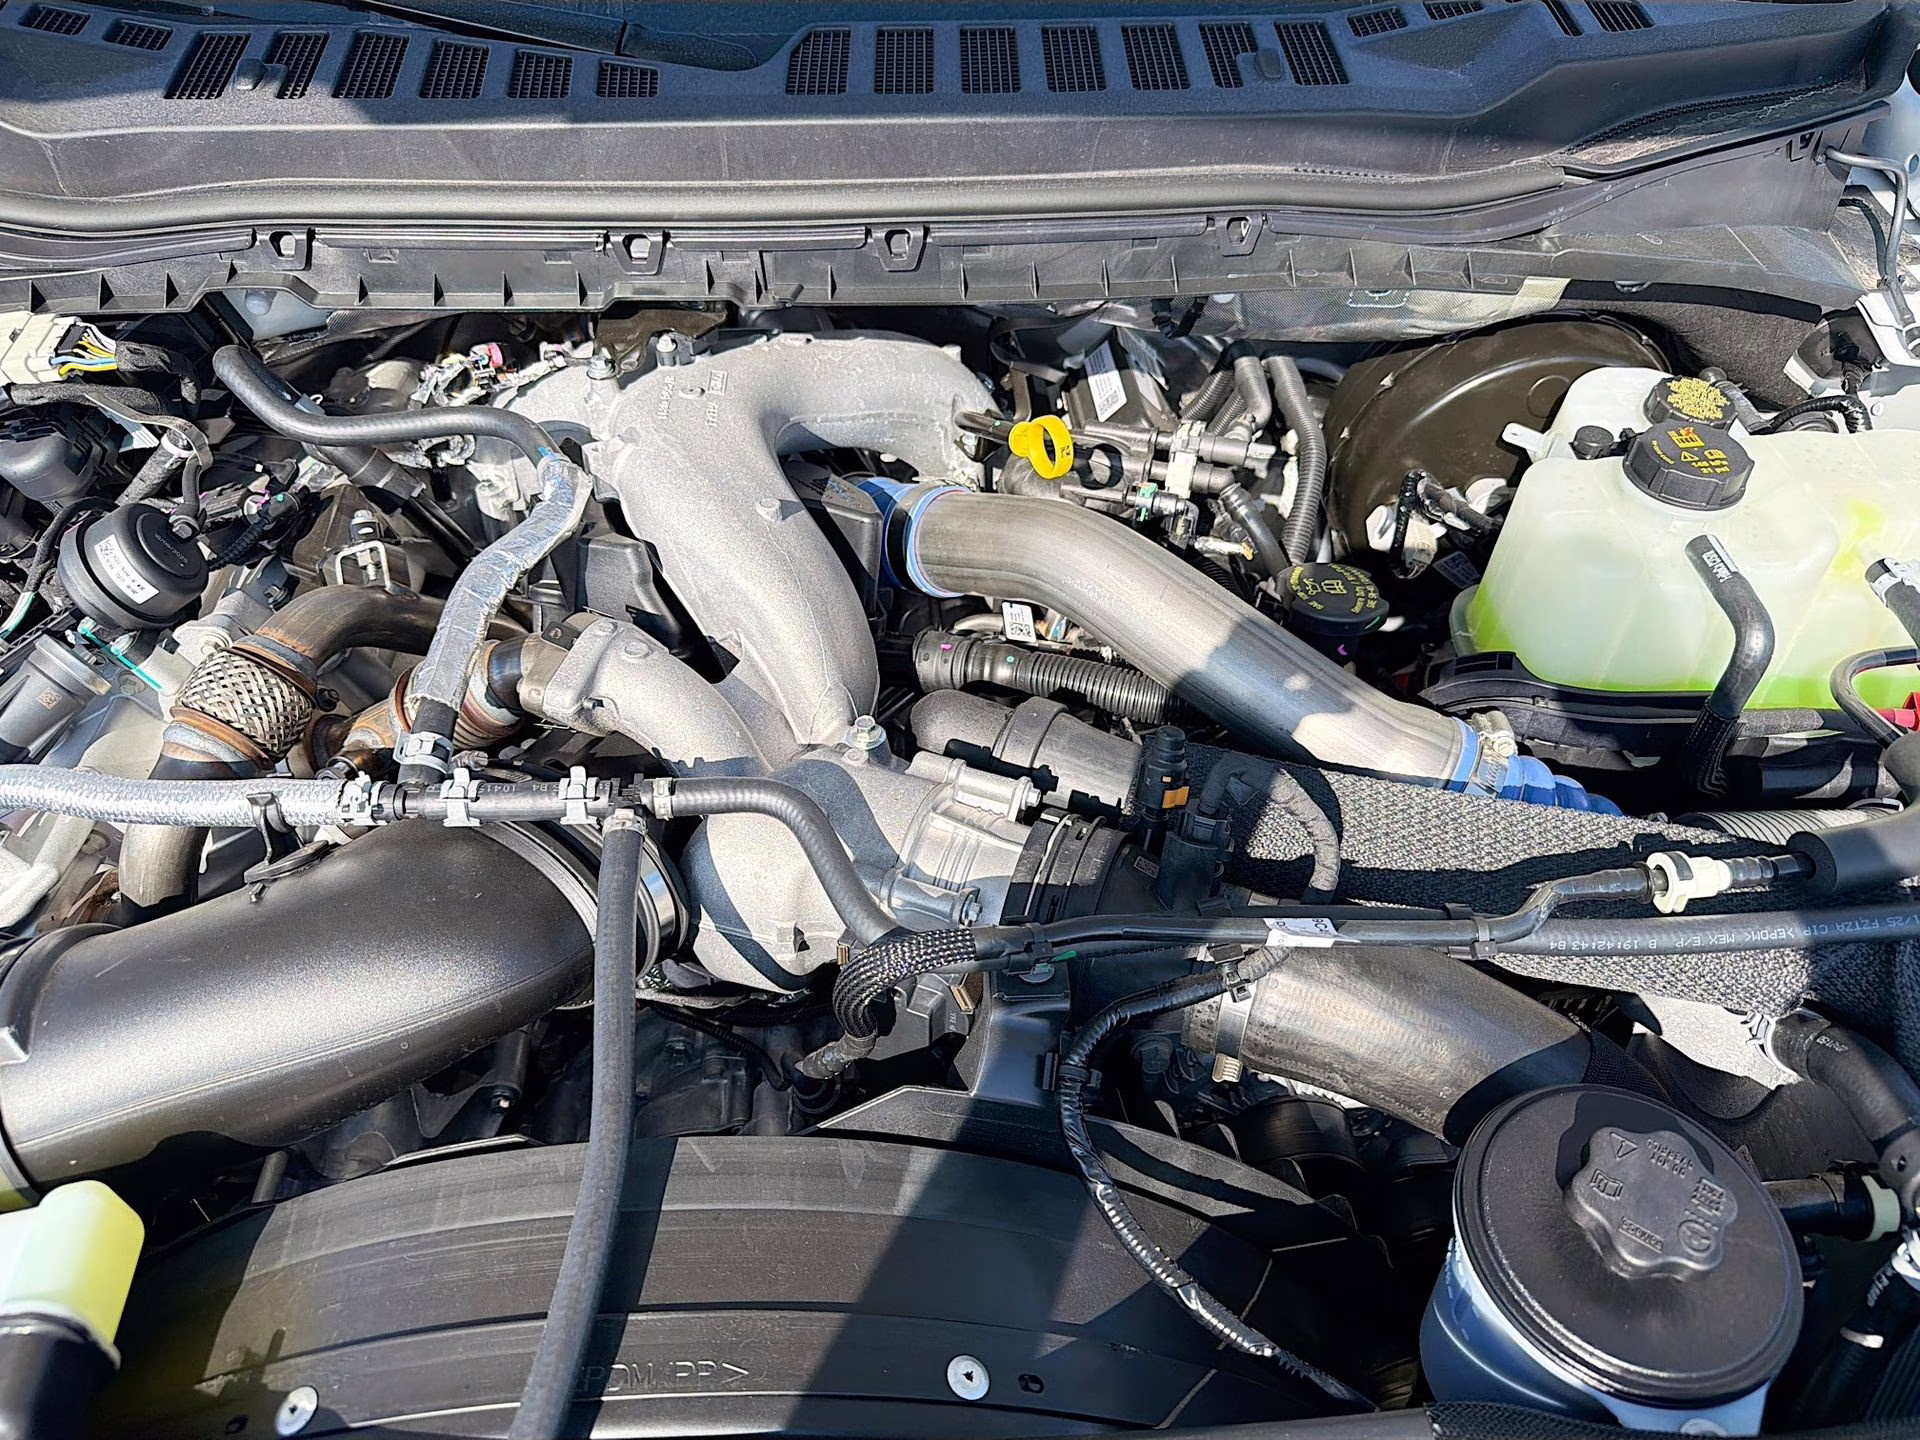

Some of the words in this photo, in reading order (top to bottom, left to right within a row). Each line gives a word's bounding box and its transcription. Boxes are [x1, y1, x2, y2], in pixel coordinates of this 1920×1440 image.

[1549, 940, 1566, 950] B4
[1571, 939, 1639, 950] 19:42:43
[1709, 933, 1735, 946] MEX
